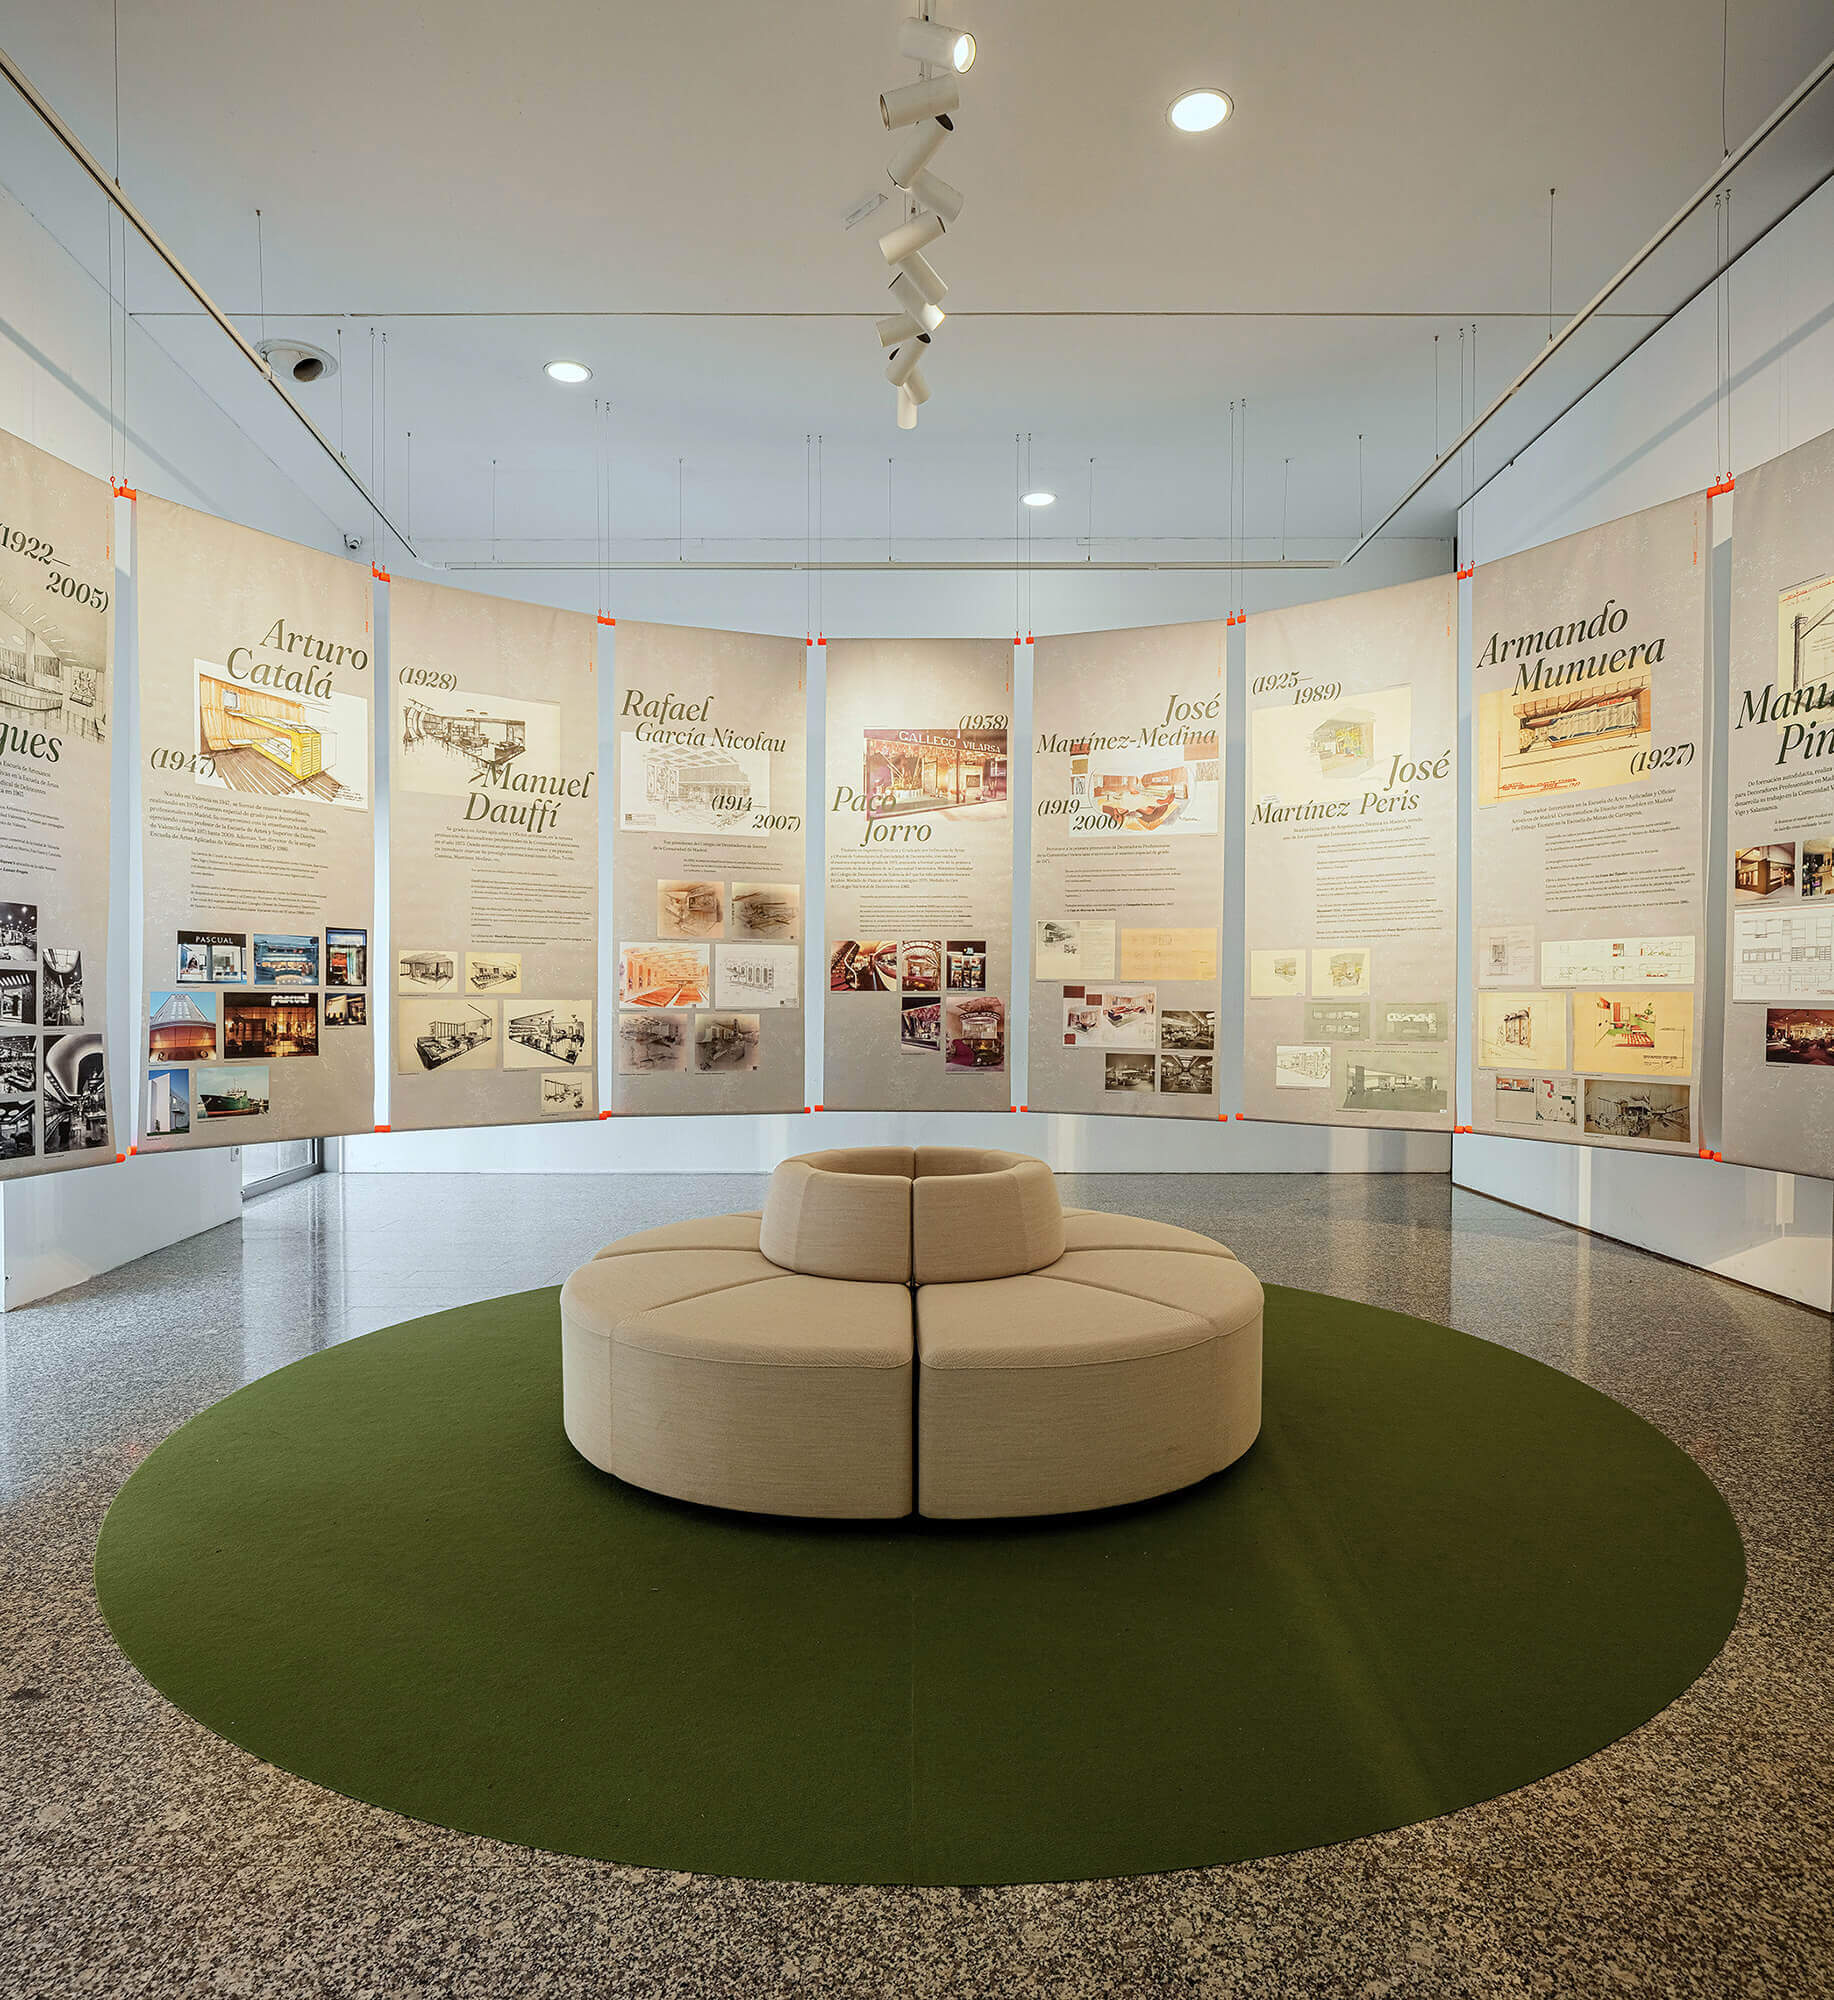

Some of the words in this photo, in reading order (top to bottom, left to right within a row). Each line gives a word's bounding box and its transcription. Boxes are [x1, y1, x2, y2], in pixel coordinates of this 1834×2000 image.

[0, 522, 71, 567] 1922—
[46, 571, 109, 614] 2005)
[259, 618, 369, 671] Arturo
[1477, 599, 1629, 669] Armando
[227, 647, 334, 699] Catalá
[398, 666, 458, 692] (1928)
[1512, 638, 1666, 697] Munuera
[620, 689, 715, 725] Rafael
[1161, 693, 1221, 727] José
[1292, 682, 1342, 706] 1989)
[635, 721, 706, 747] García
[711, 727, 787, 753] Nicolau
[1036, 725, 1217, 754] Martínez-Medina
[150, 747, 217, 777] (1947)
[1384, 750, 1451, 792] José
[1630, 742, 1696, 775] (1927)
[481, 760, 595, 799] Manuel
[464, 792, 562, 834] Dauffí
[832, 786, 897, 812] Paco
[1251, 800, 1350, 825] Martínez
[1359, 789, 1420, 815] Peris
[752, 815, 801, 832] 2007)
[860, 816, 932, 847] Jorro
[1072, 814, 1125, 831] 2006)
[195, 935, 234, 945] PASCUAL
